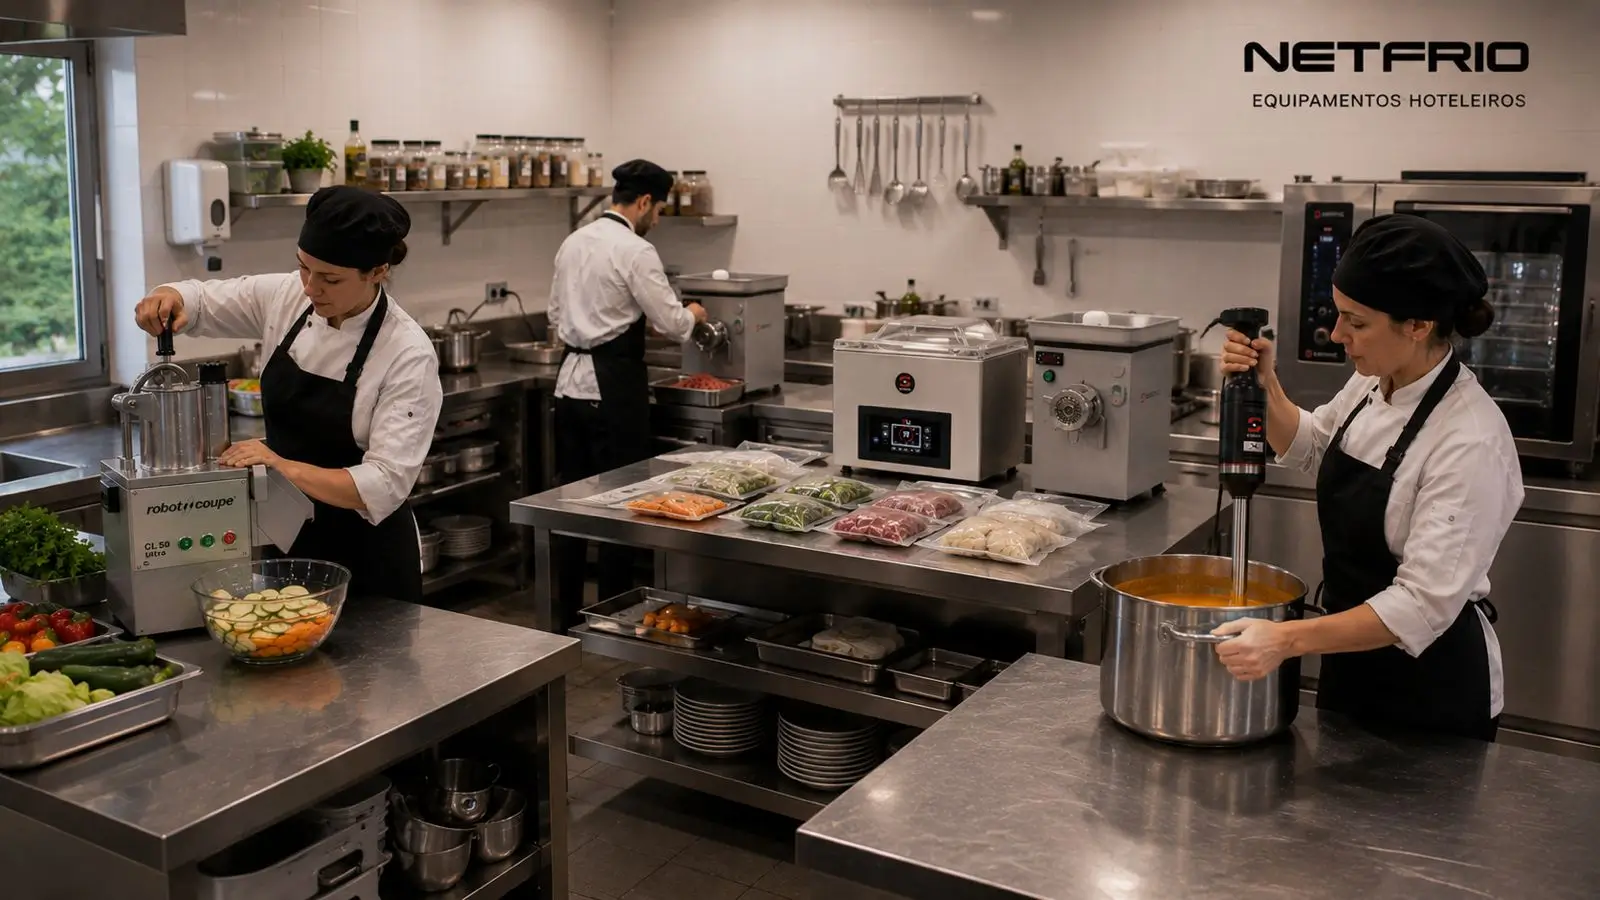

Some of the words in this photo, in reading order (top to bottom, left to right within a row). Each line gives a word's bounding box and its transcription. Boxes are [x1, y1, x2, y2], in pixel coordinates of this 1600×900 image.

[146, 500, 183, 515] robot
[194, 497, 234, 510] coupe
[144, 542, 157, 550] CL
[159, 540, 170, 549] 50
